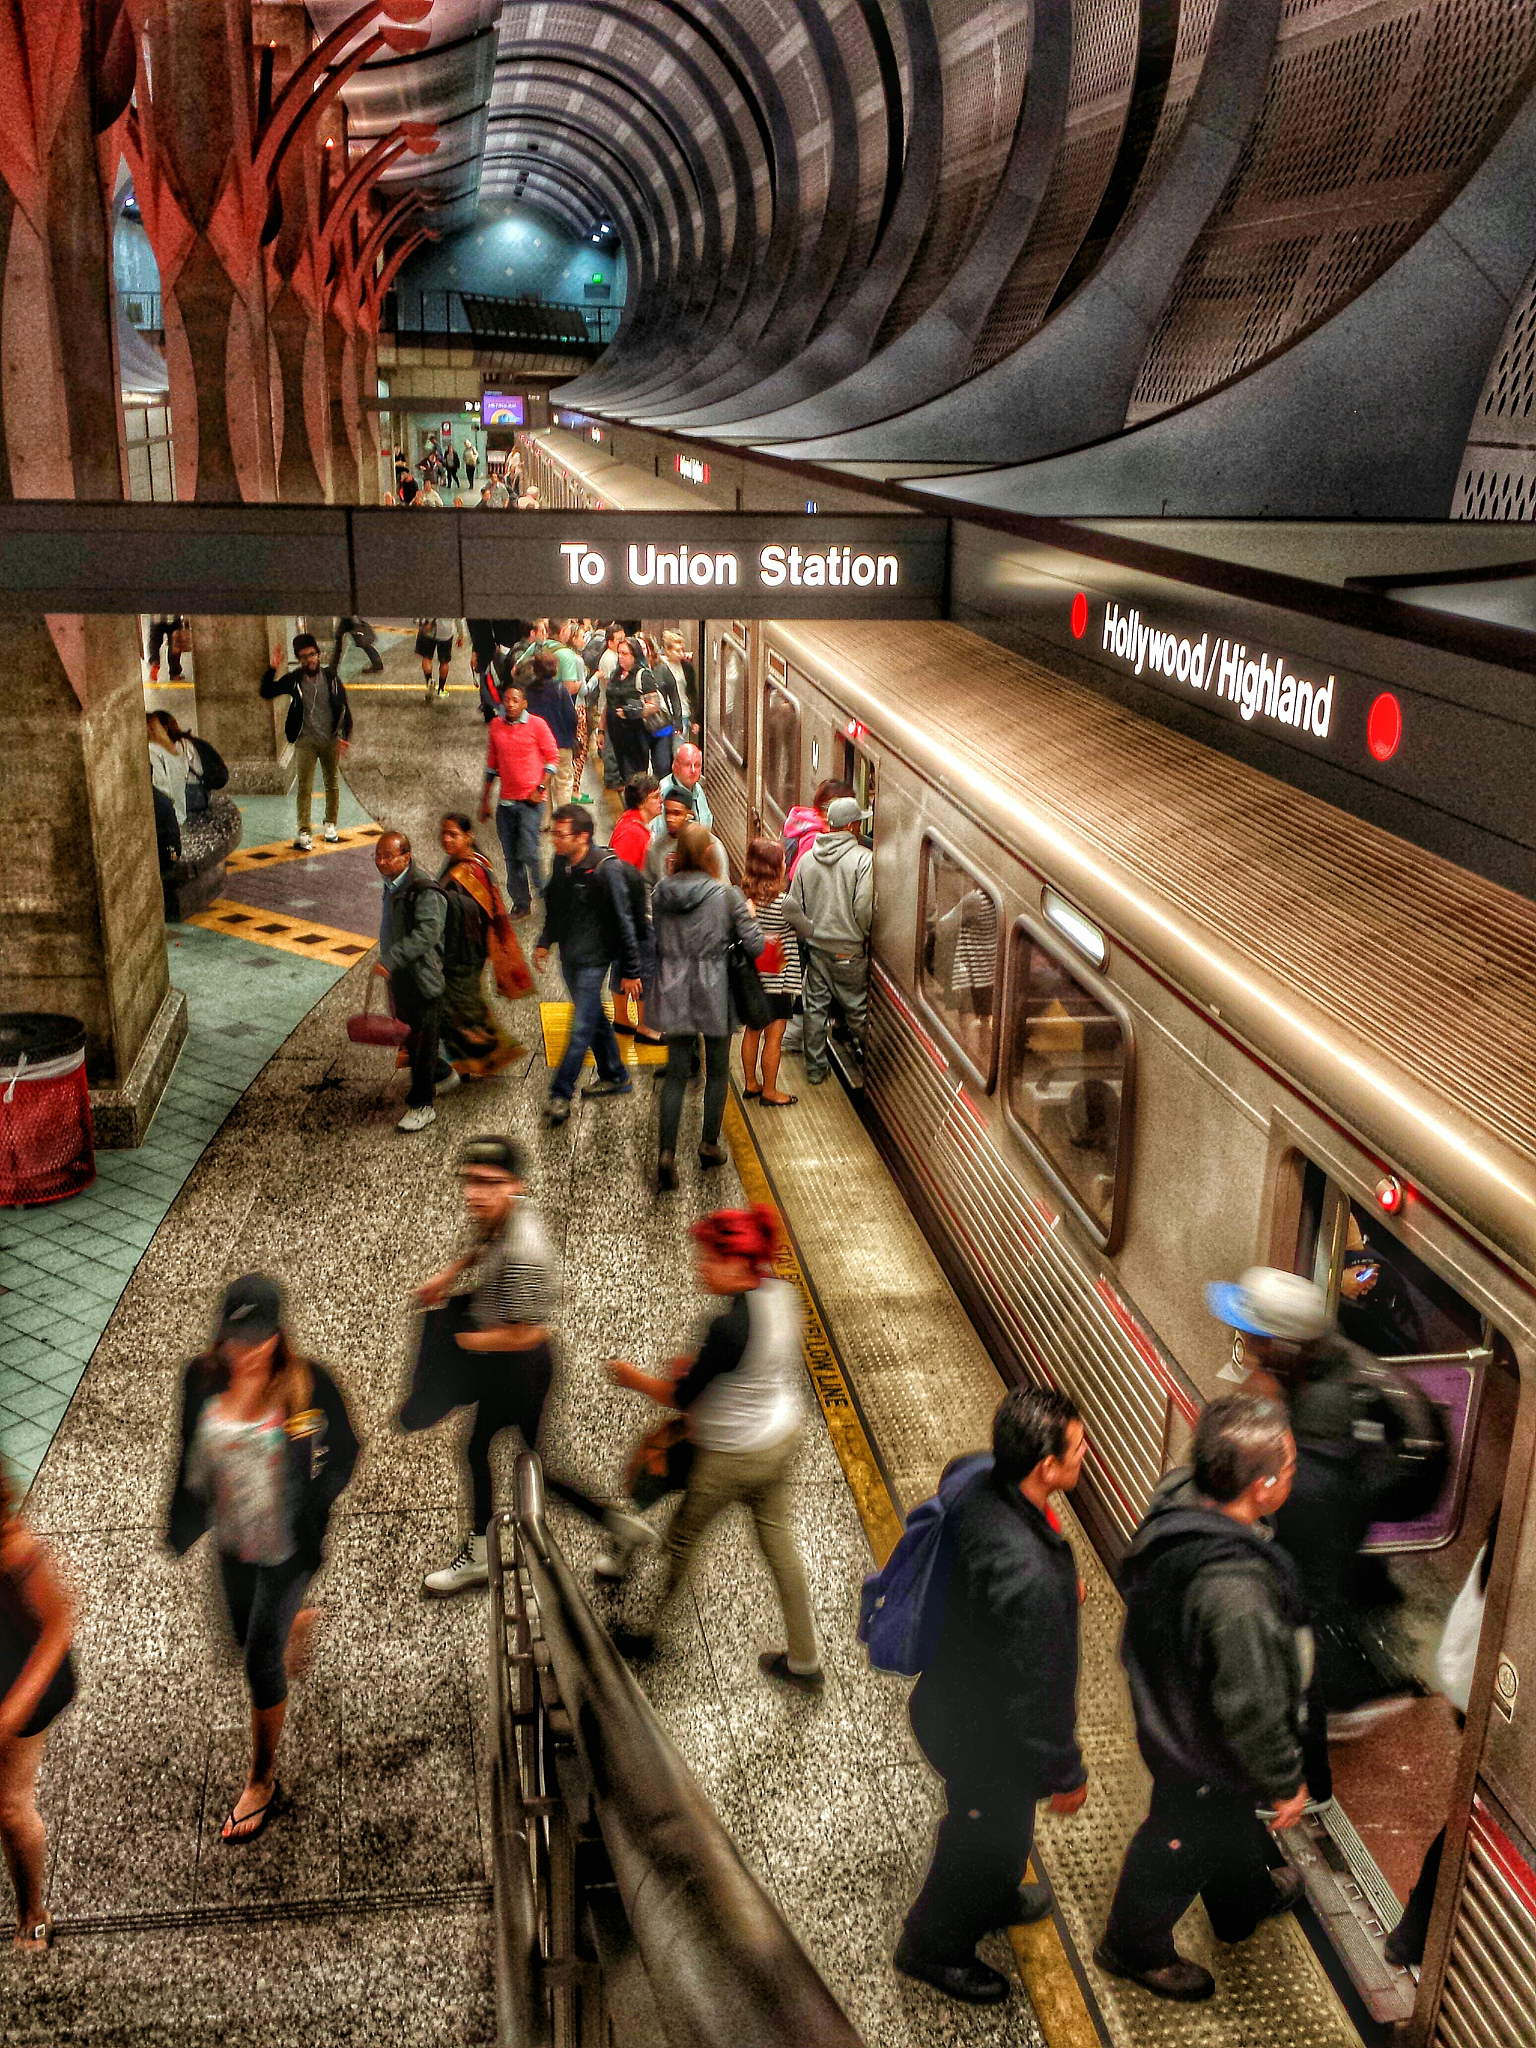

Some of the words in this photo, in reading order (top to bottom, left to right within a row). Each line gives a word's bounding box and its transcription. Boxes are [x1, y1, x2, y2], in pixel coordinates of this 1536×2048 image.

[559, 543, 605, 585] To
[627, 543, 738, 585] Union
[760, 544, 899, 586] Station
[1102, 601, 1336, 738] Hollywood/Highland
[817, 1374, 849, 1407] LINE
